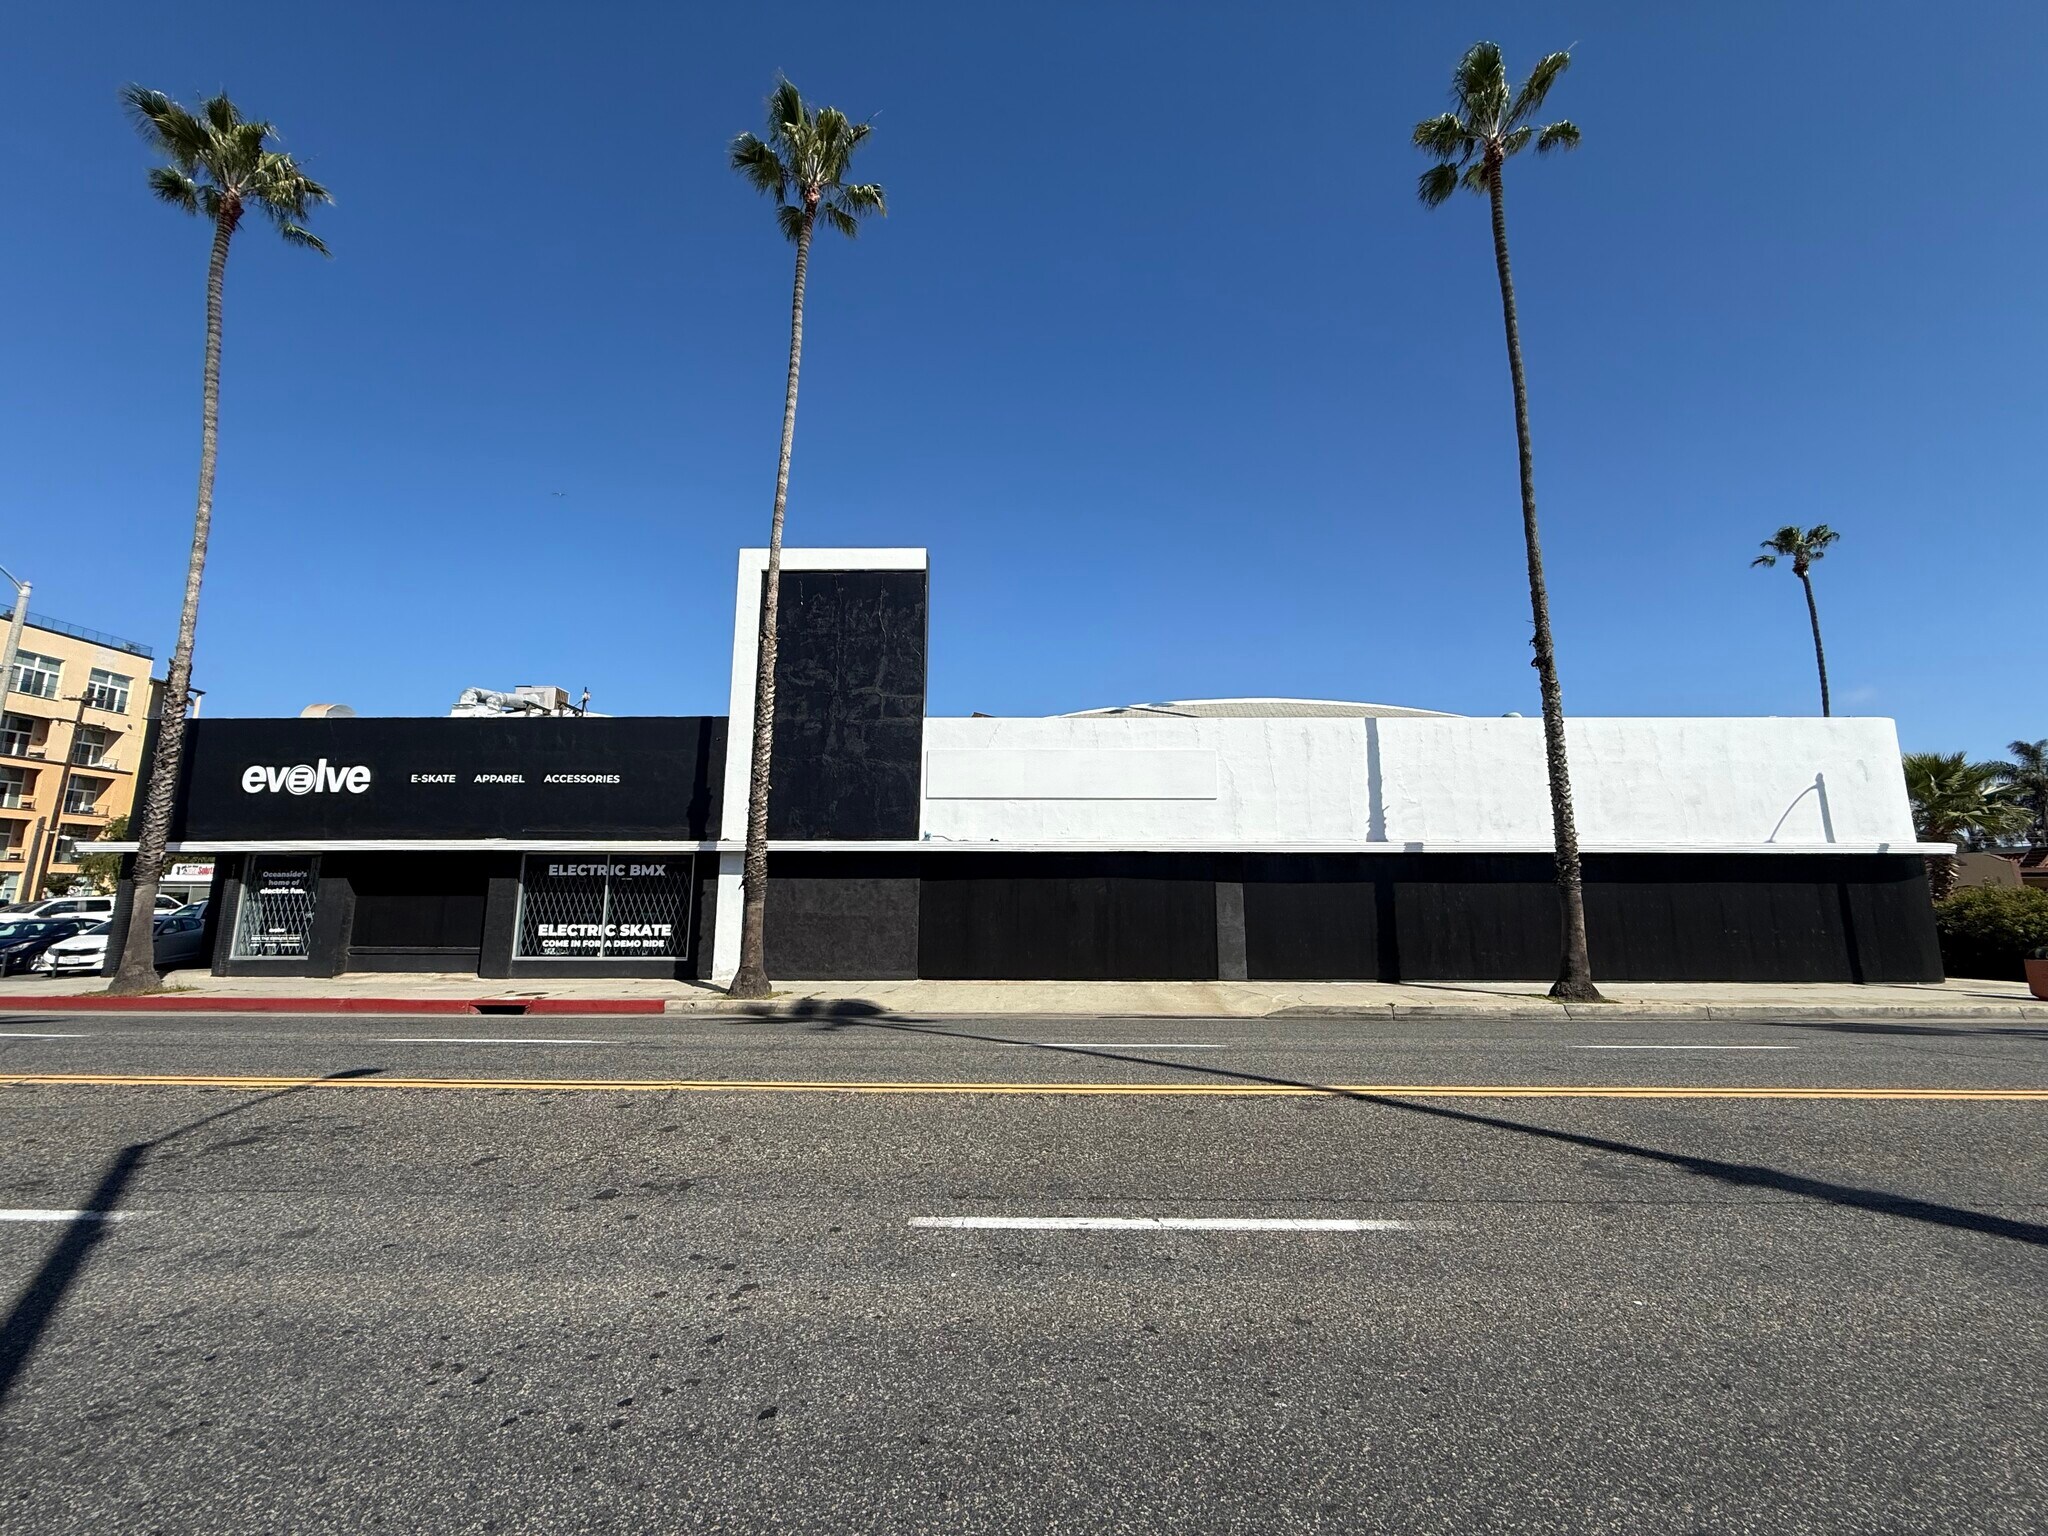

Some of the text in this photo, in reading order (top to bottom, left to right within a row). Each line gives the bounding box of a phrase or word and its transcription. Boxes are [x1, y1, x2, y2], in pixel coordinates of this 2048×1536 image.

[242, 759, 371, 795] evolve
[474, 775, 525, 783] APPAREL
[544, 775, 620, 783] ACCESSORIES
[263, 870, 307, 878] Oceanside's
[549, 864, 666, 876] ELECTRIC BMX
[537, 924, 672, 937] ELECTRIC SKATE
